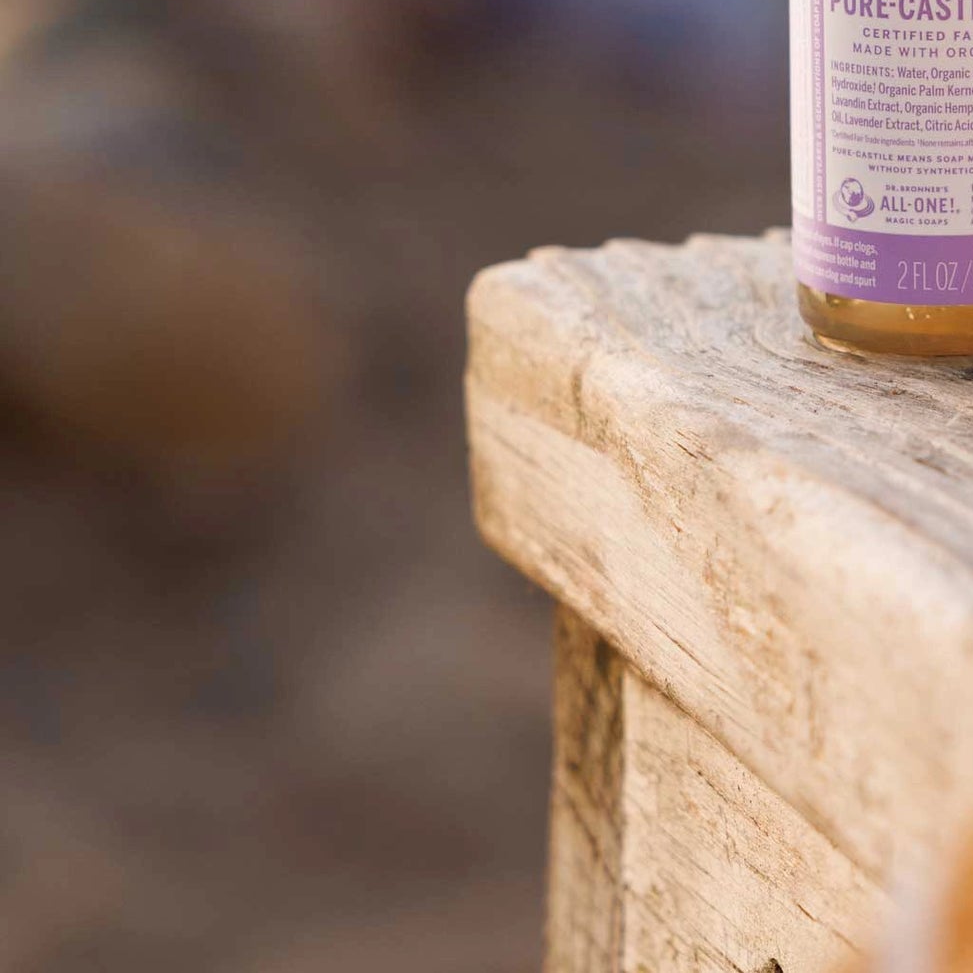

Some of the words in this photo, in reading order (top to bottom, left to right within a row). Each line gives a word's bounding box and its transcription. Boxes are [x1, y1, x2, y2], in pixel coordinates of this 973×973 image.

[863, 27, 945, 41] CERTIFIED
[853, 43, 892, 56] MADE
[899, 47, 938, 58] WITH
[831, 60, 894, 78] INGREDIENTS:
[897, 66, 929, 80] Water,
[931, 67, 970, 82] Organic
[878, 82, 917, 98] Organic
[919, 84, 945, 97] Palm
[832, 93, 866, 109] Lavandin
[868, 98, 903, 114] Extract,
[905, 102, 943, 116] Organic
[945, 102, 973, 116] Hemp
[845, 113, 883, 128] Lavender
[886, 117, 923, 132] Extract,
[925, 120, 952, 132] Citric
[832, 145, 893, 161] PURE-CASTILE
[897, 155, 932, 163] MEANS
[936, 155, 964, 163] SOAP
[868, 164, 913, 174] WITHOUT
[886, 217, 914, 225] MAGIC
[860, 259, 876, 270] and
[898, 261, 909, 289] 2
[913, 262, 932, 291] FL
[936, 262, 958, 291] OZ
